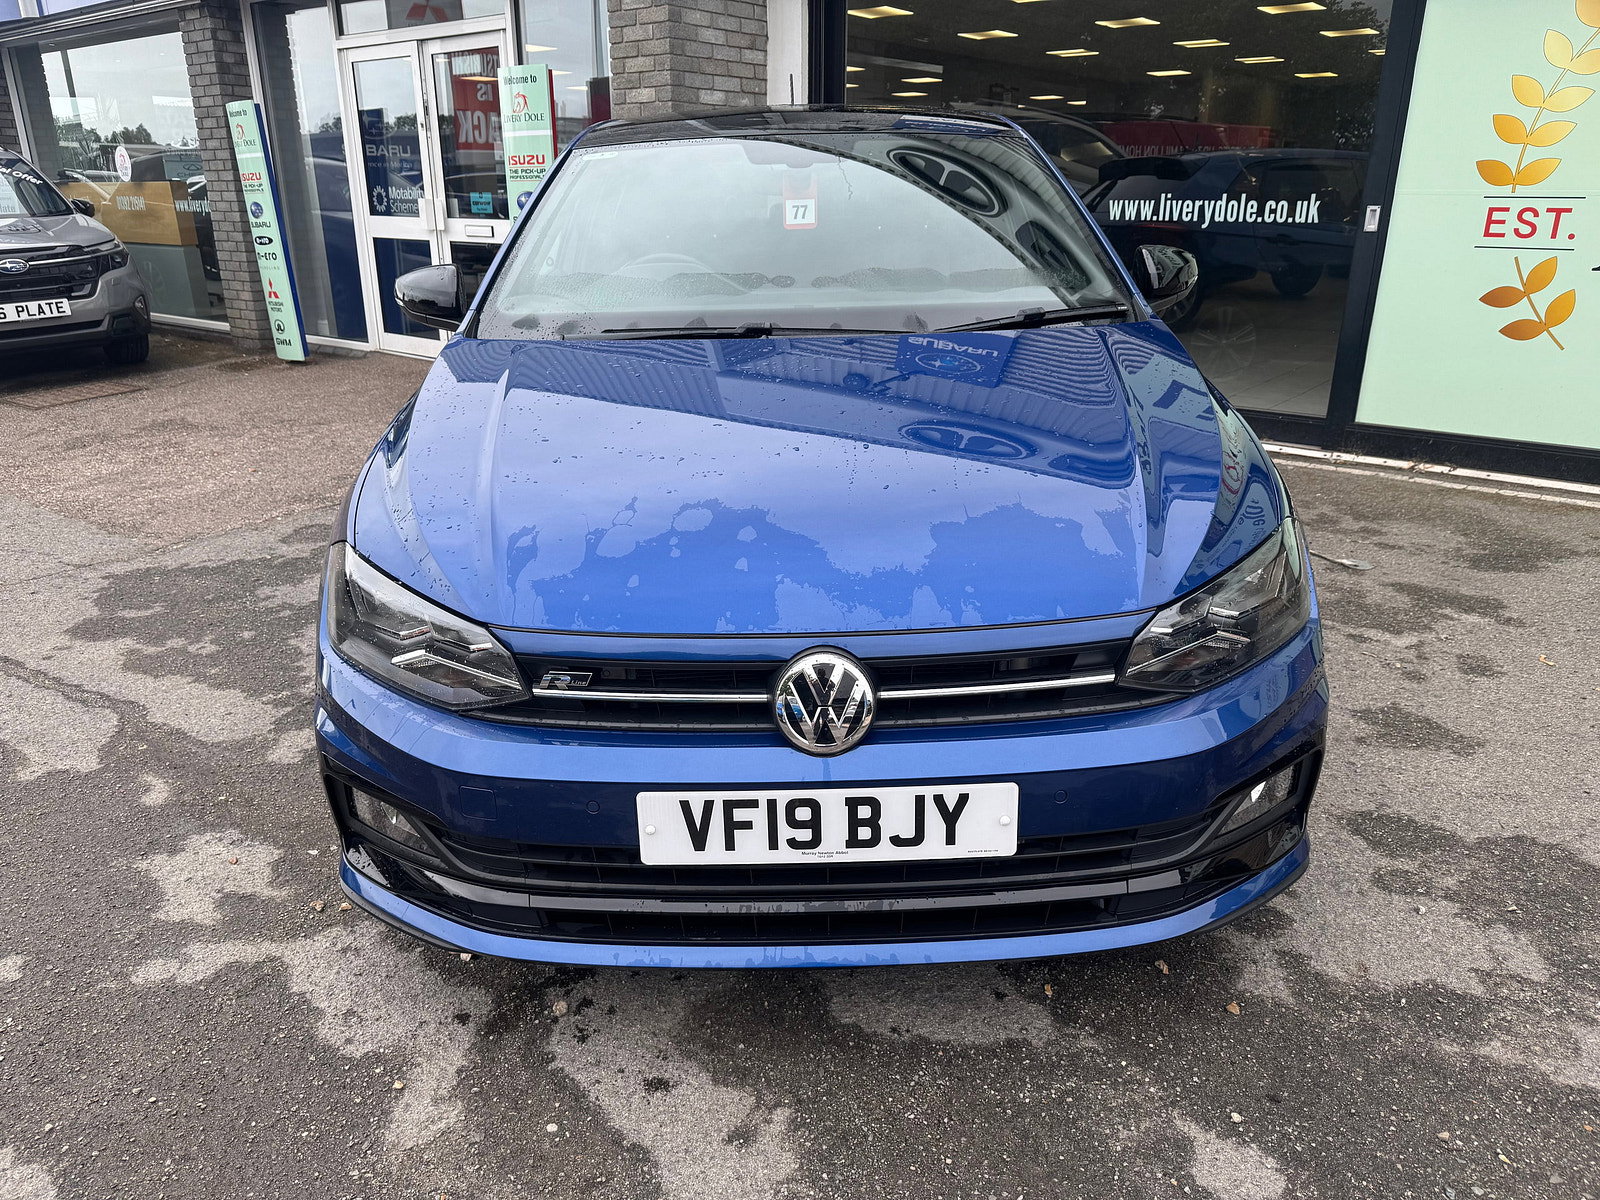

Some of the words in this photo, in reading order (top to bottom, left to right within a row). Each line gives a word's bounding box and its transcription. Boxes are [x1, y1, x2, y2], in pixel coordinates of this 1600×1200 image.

[530, 74, 537, 83] to
[524, 112, 545, 121] DOLE
[366, 144, 411, 157] BARU
[508, 154, 546, 166] ISUZU
[12, 170, 44, 185] Offer
[389, 201, 419, 213] Scheme
[792, 204, 808, 219] 77
[1109, 193, 1321, 229] www.liverydole.co.uk
[1483, 206, 1576, 240] EST.
[15, 301, 66, 318] PLATE
[679, 797, 822, 851] VF19
[845, 792, 970, 849] BJY
